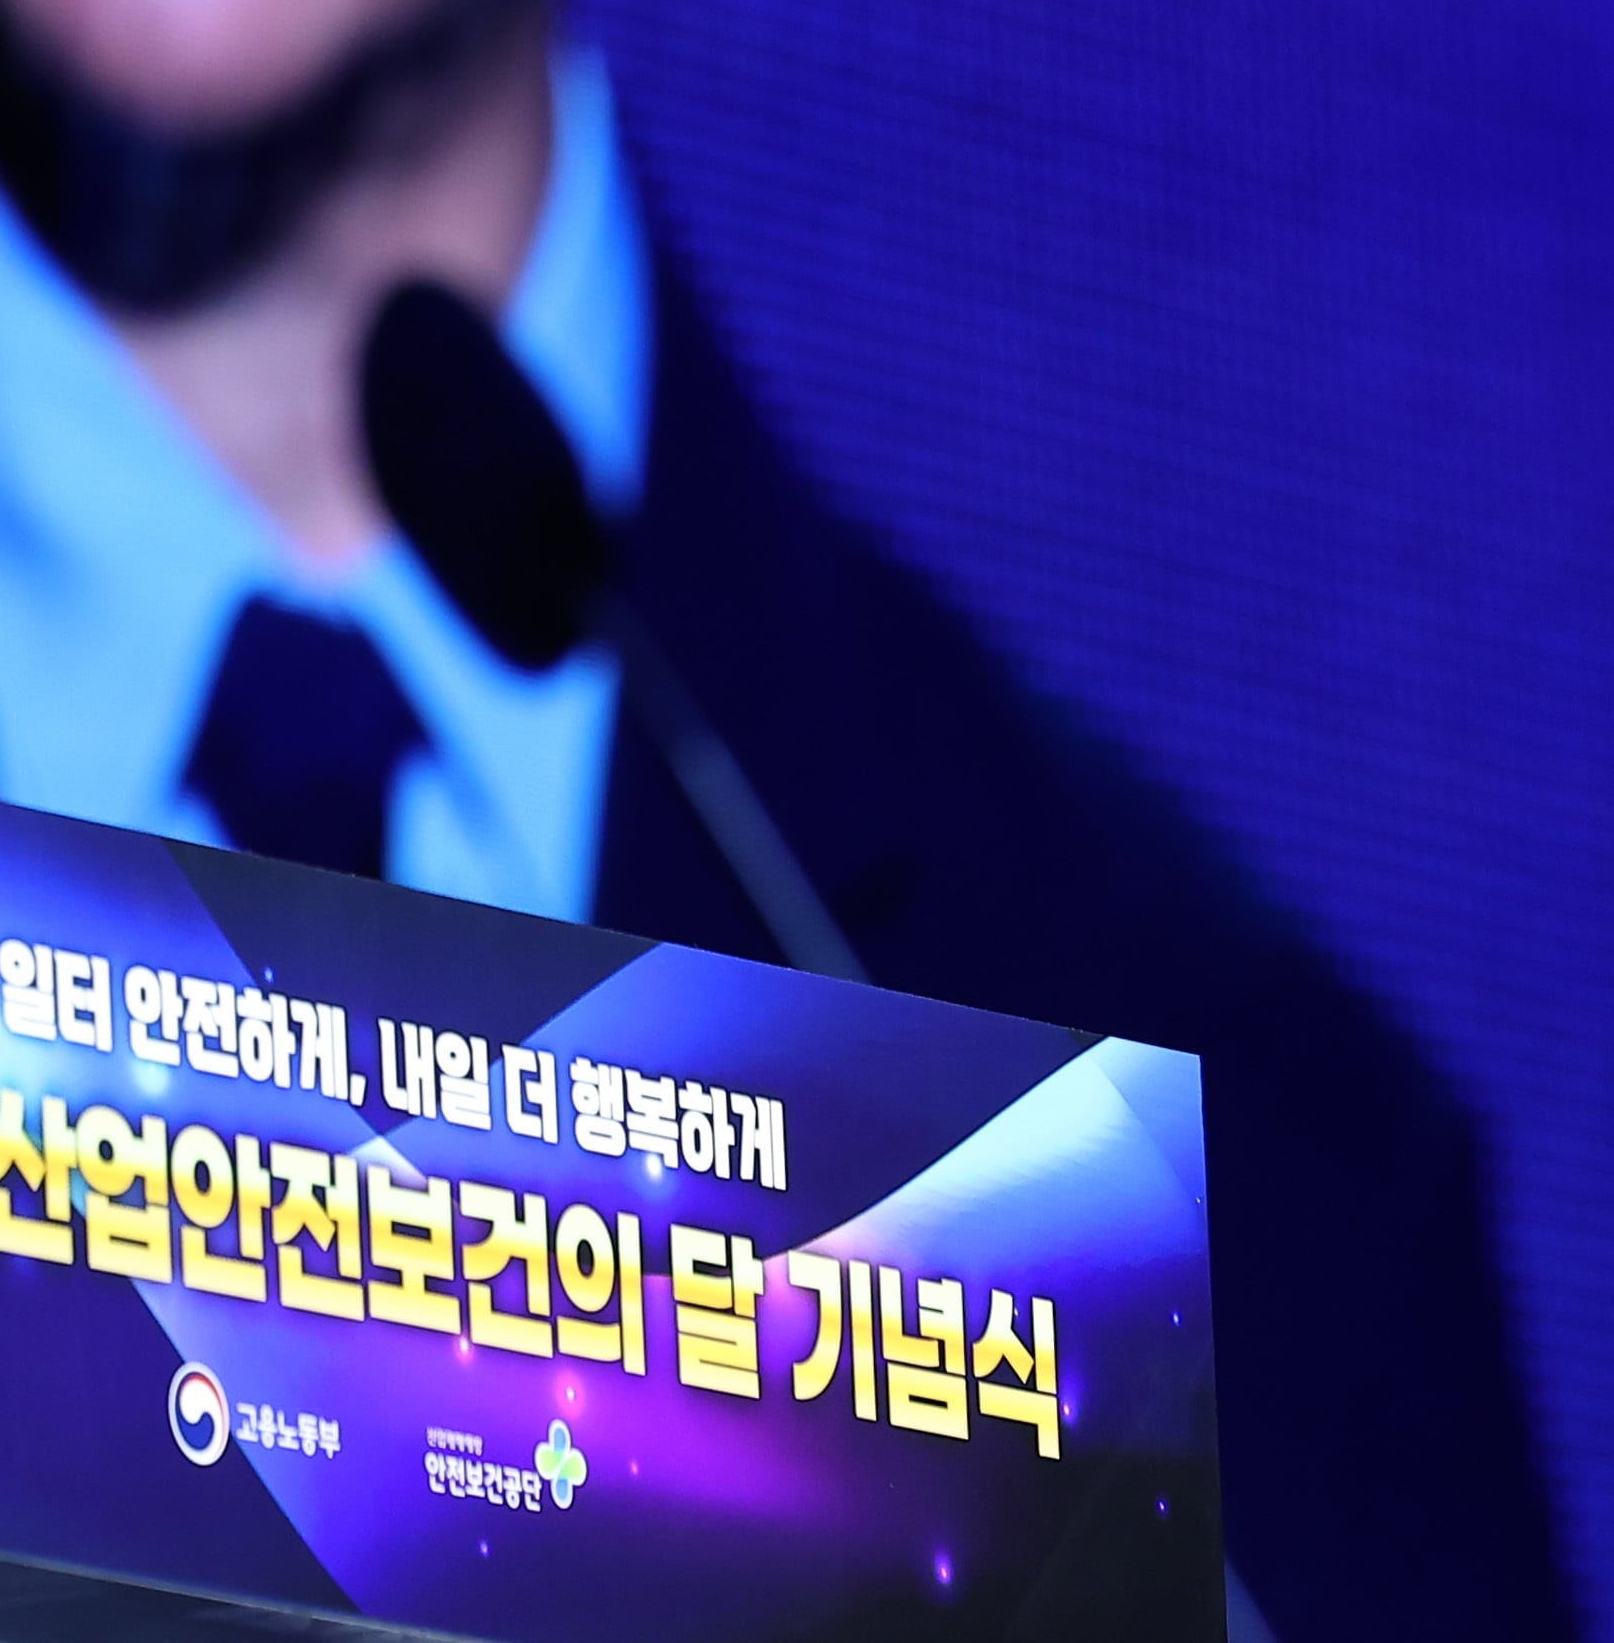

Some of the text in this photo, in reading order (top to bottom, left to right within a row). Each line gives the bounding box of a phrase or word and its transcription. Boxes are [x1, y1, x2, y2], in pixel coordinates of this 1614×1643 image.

[124, 964, 367, 1107] 안전하게,
[377, 1017, 492, 1131] 내일
[502, 1043, 559, 1145] 더
[569, 1056, 787, 1192] 행복하게
[670, 1222, 765, 1400] 달
[787, 1249, 1061, 1461] 기념식
[235, 1401, 342, 1459] 고용노동부
[424, 1450, 543, 1513] 안전보건공단
